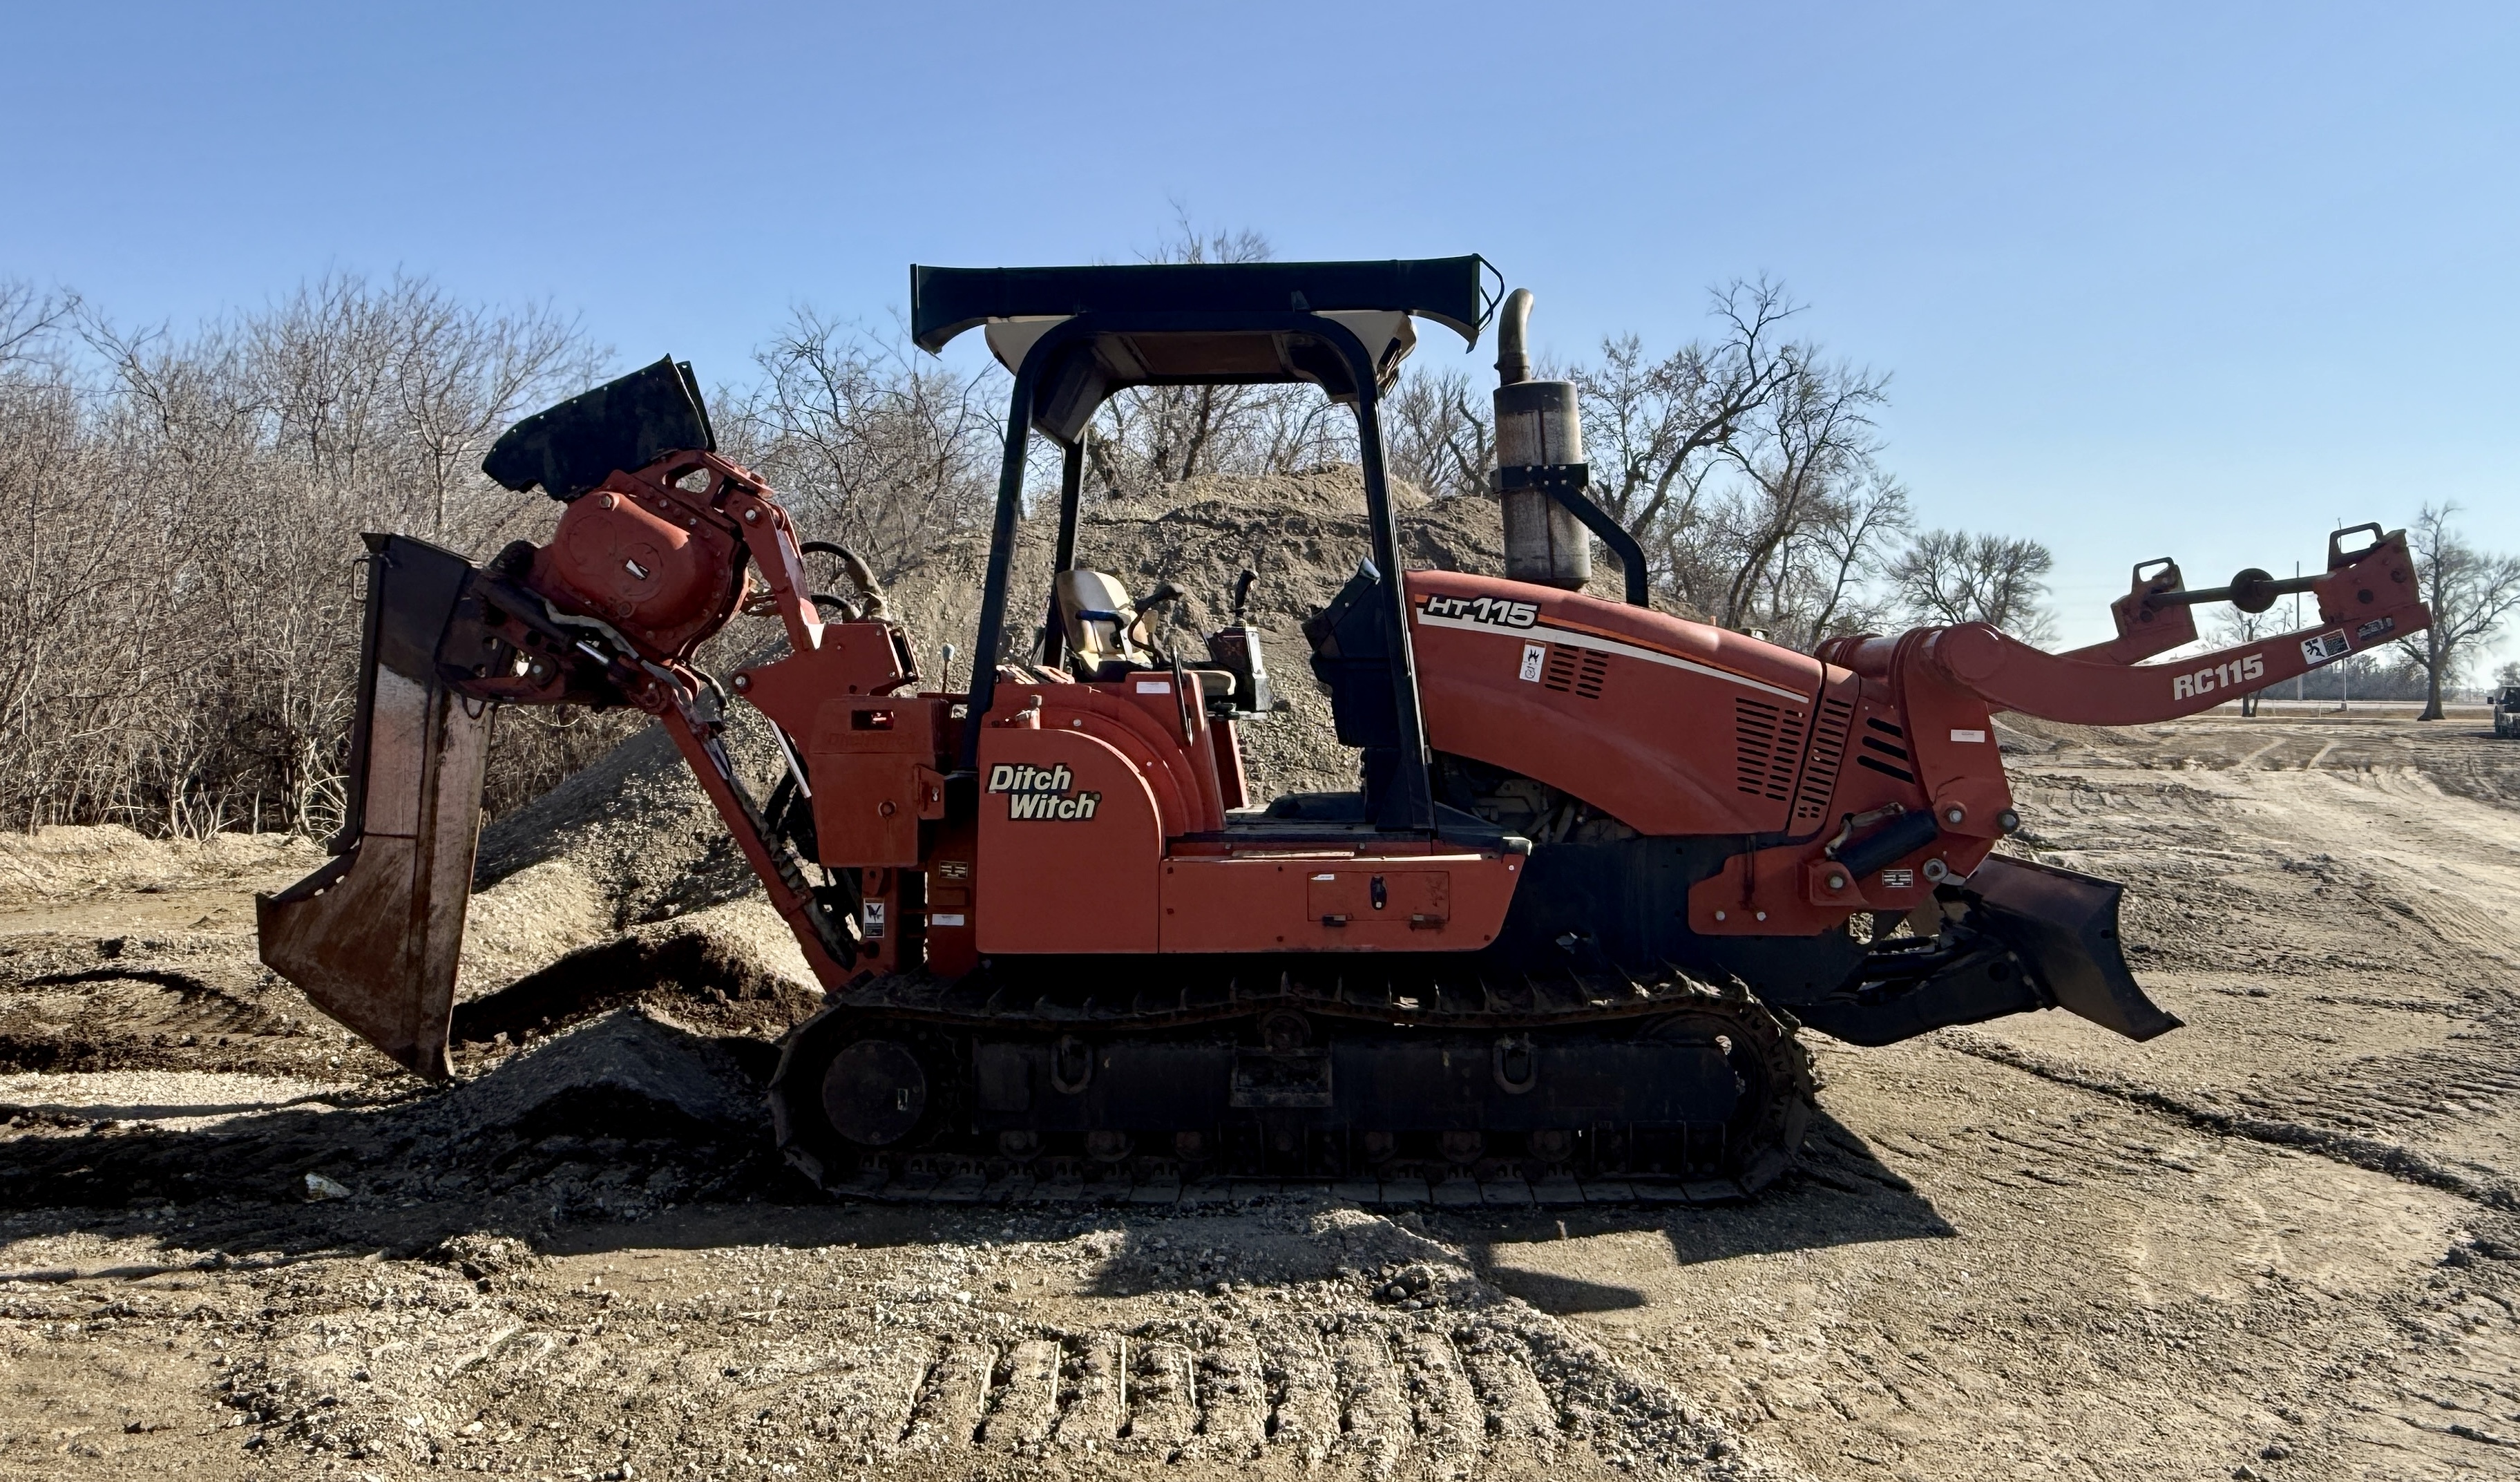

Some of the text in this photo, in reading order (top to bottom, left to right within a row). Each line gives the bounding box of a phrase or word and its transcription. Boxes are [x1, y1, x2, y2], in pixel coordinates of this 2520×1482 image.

[1427, 597, 1538, 627] HT115
[2173, 654, 2264, 701] RC115
[989, 765, 1071, 790] Ditch
[1011, 794, 1096, 819] Witch
